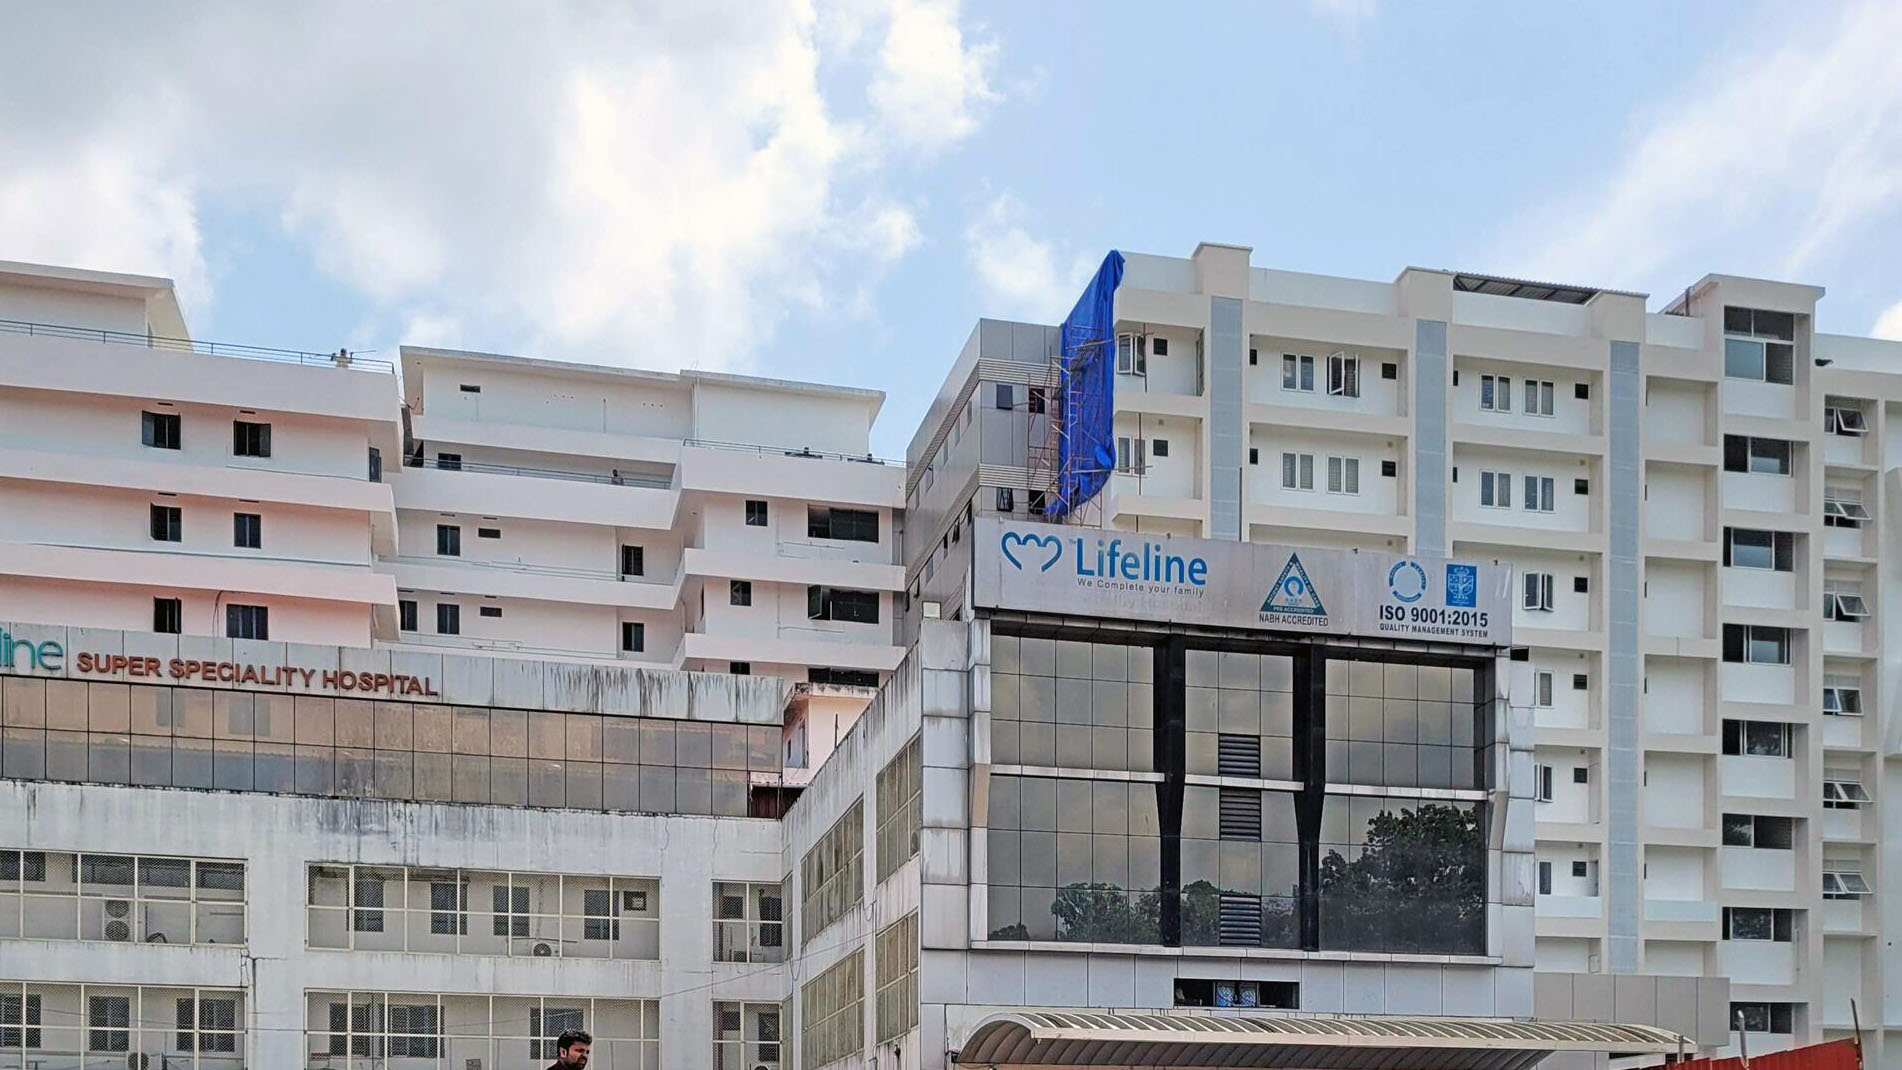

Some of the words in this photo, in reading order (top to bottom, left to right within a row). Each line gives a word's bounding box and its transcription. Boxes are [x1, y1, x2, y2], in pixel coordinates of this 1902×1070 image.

[1076, 537, 1208, 586] Lifeline
[1077, 577, 1092, 587] We
[1097, 579, 1144, 591] Complete
[1149, 585, 1171, 594] your
[1174, 586, 1204, 598] family
[1259, 613, 1280, 624] NABH
[1281, 615, 1329, 627] ACCREDITED
[1379, 604, 1406, 622] ISO
[1410, 606, 1489, 628] 9001:2015
[1379, 622, 1410, 632] QUALITY
[1411, 625, 1459, 636] MANAGEMENT
[1461, 628, 1489, 638] SYSTEM
[77, 651, 162, 678] SUPER
[169, 658, 316, 688] SPECIALITY
[322, 669, 439, 697] HOSPITAL
